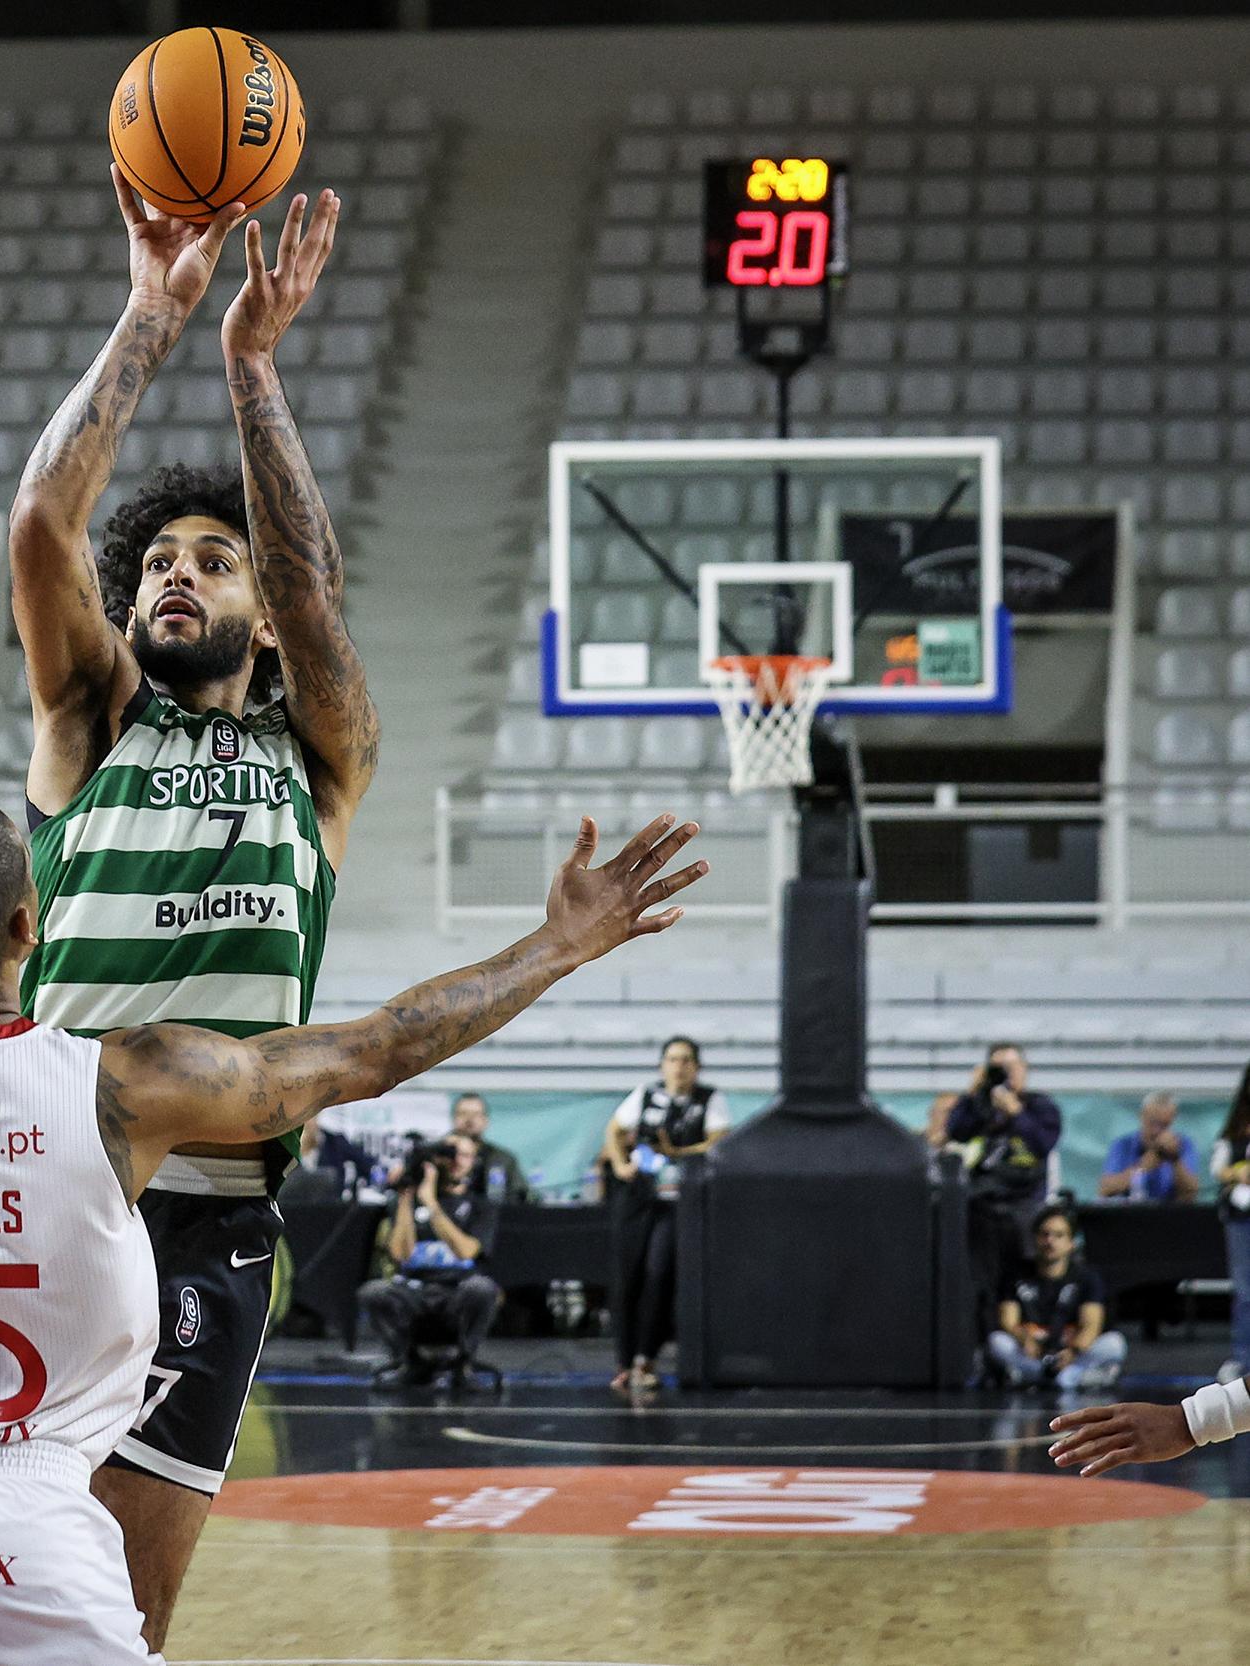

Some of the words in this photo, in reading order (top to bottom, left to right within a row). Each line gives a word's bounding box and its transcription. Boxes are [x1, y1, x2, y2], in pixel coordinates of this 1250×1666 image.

[124, 82, 139, 125] FIBA
[238, 36, 275, 147] Wilson
[727, 211, 829, 287] 2.0
[149, 765, 291, 805] SPORTING
[205, 808, 248, 884] 7
[155, 889, 285, 928] Buildity.
